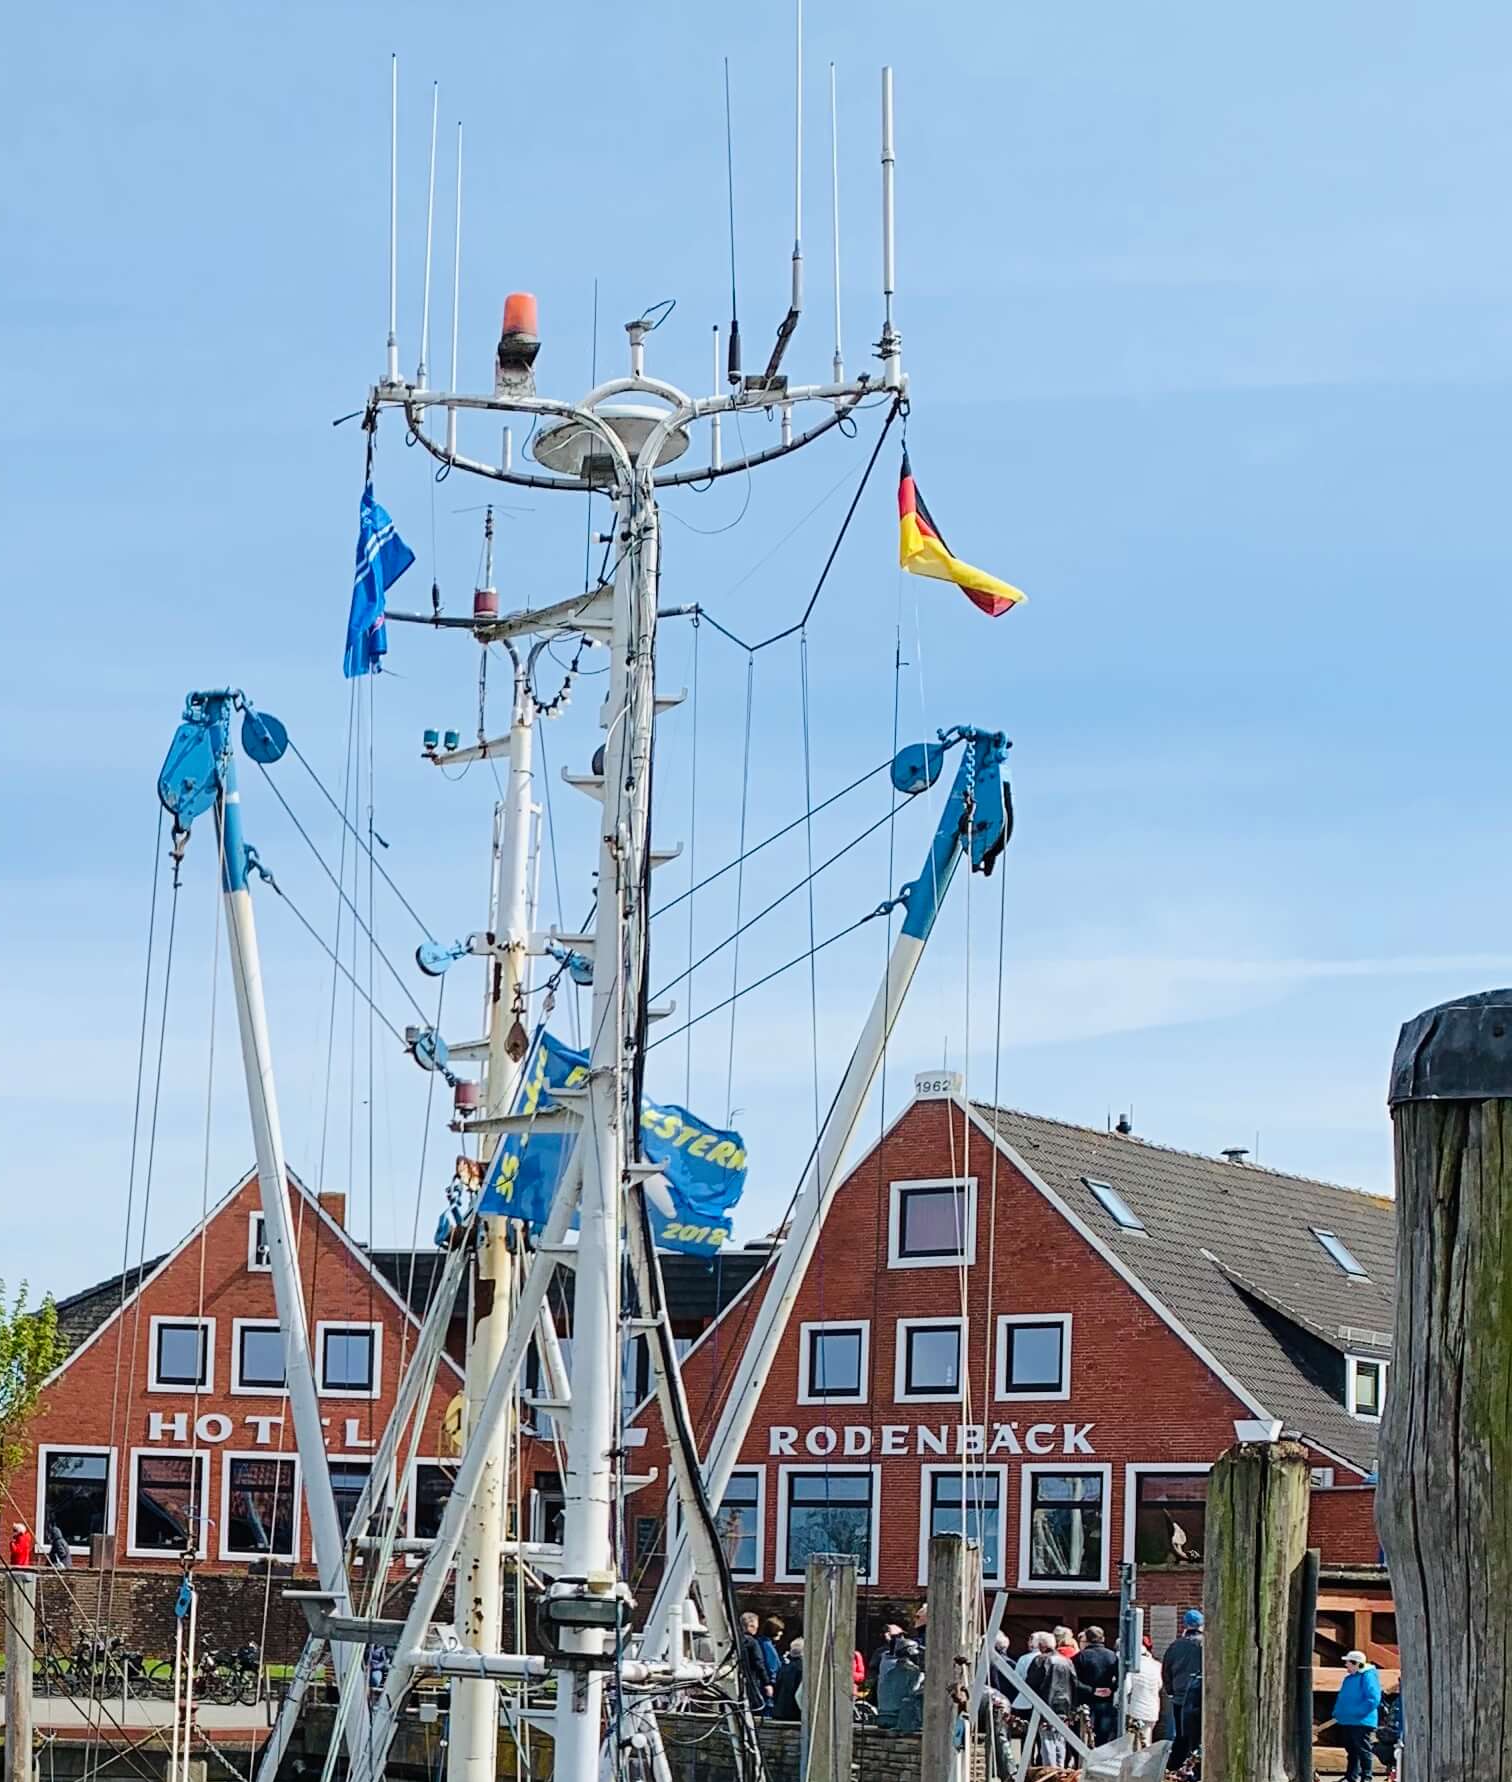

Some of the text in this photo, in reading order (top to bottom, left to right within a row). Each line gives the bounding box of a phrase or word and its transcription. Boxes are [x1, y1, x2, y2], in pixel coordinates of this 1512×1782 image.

[915, 1079, 952, 1094] 1962
[662, 1221, 729, 1247] 2018
[148, 1412, 377, 1448] HOTL
[768, 1422, 1097, 1456] RODENBÄCK
